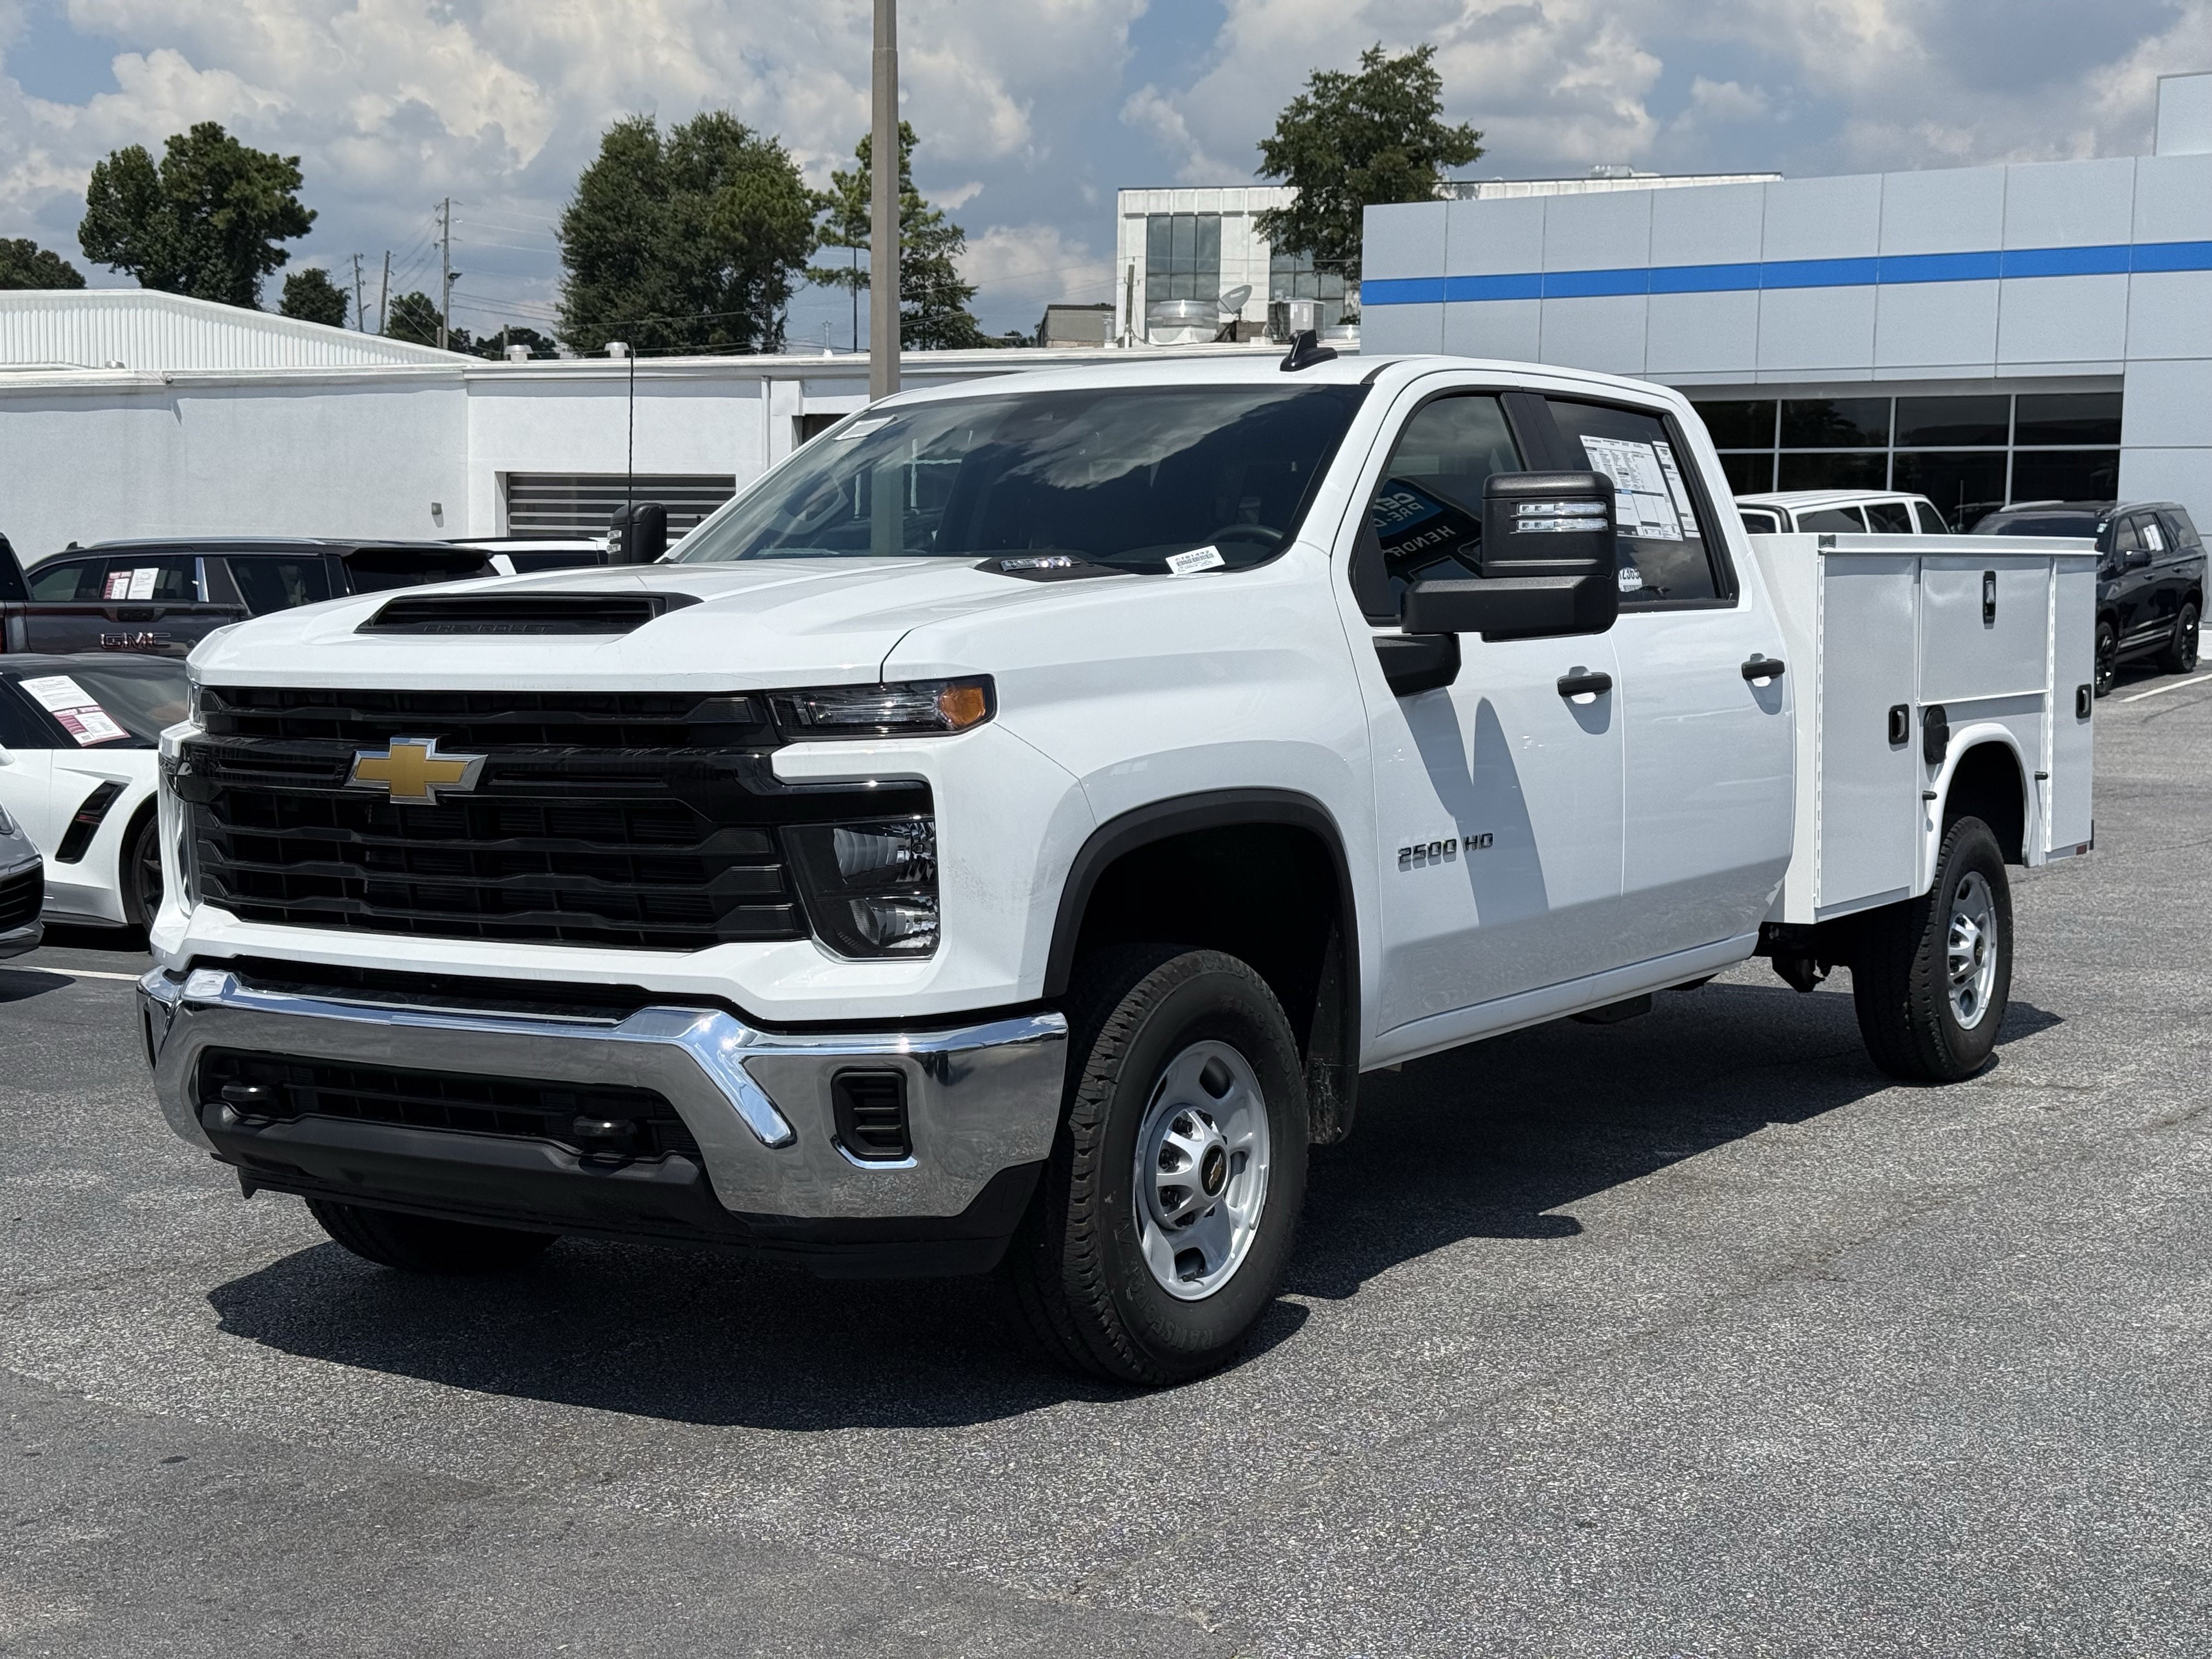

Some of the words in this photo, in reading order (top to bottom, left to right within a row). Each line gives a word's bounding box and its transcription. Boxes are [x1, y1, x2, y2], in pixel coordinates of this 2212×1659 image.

[423, 624, 554, 634] CHEVROLET
[100, 632, 171, 649] GMC
[1398, 838, 1457, 864] 2500
[1463, 832, 1493, 852] HD
